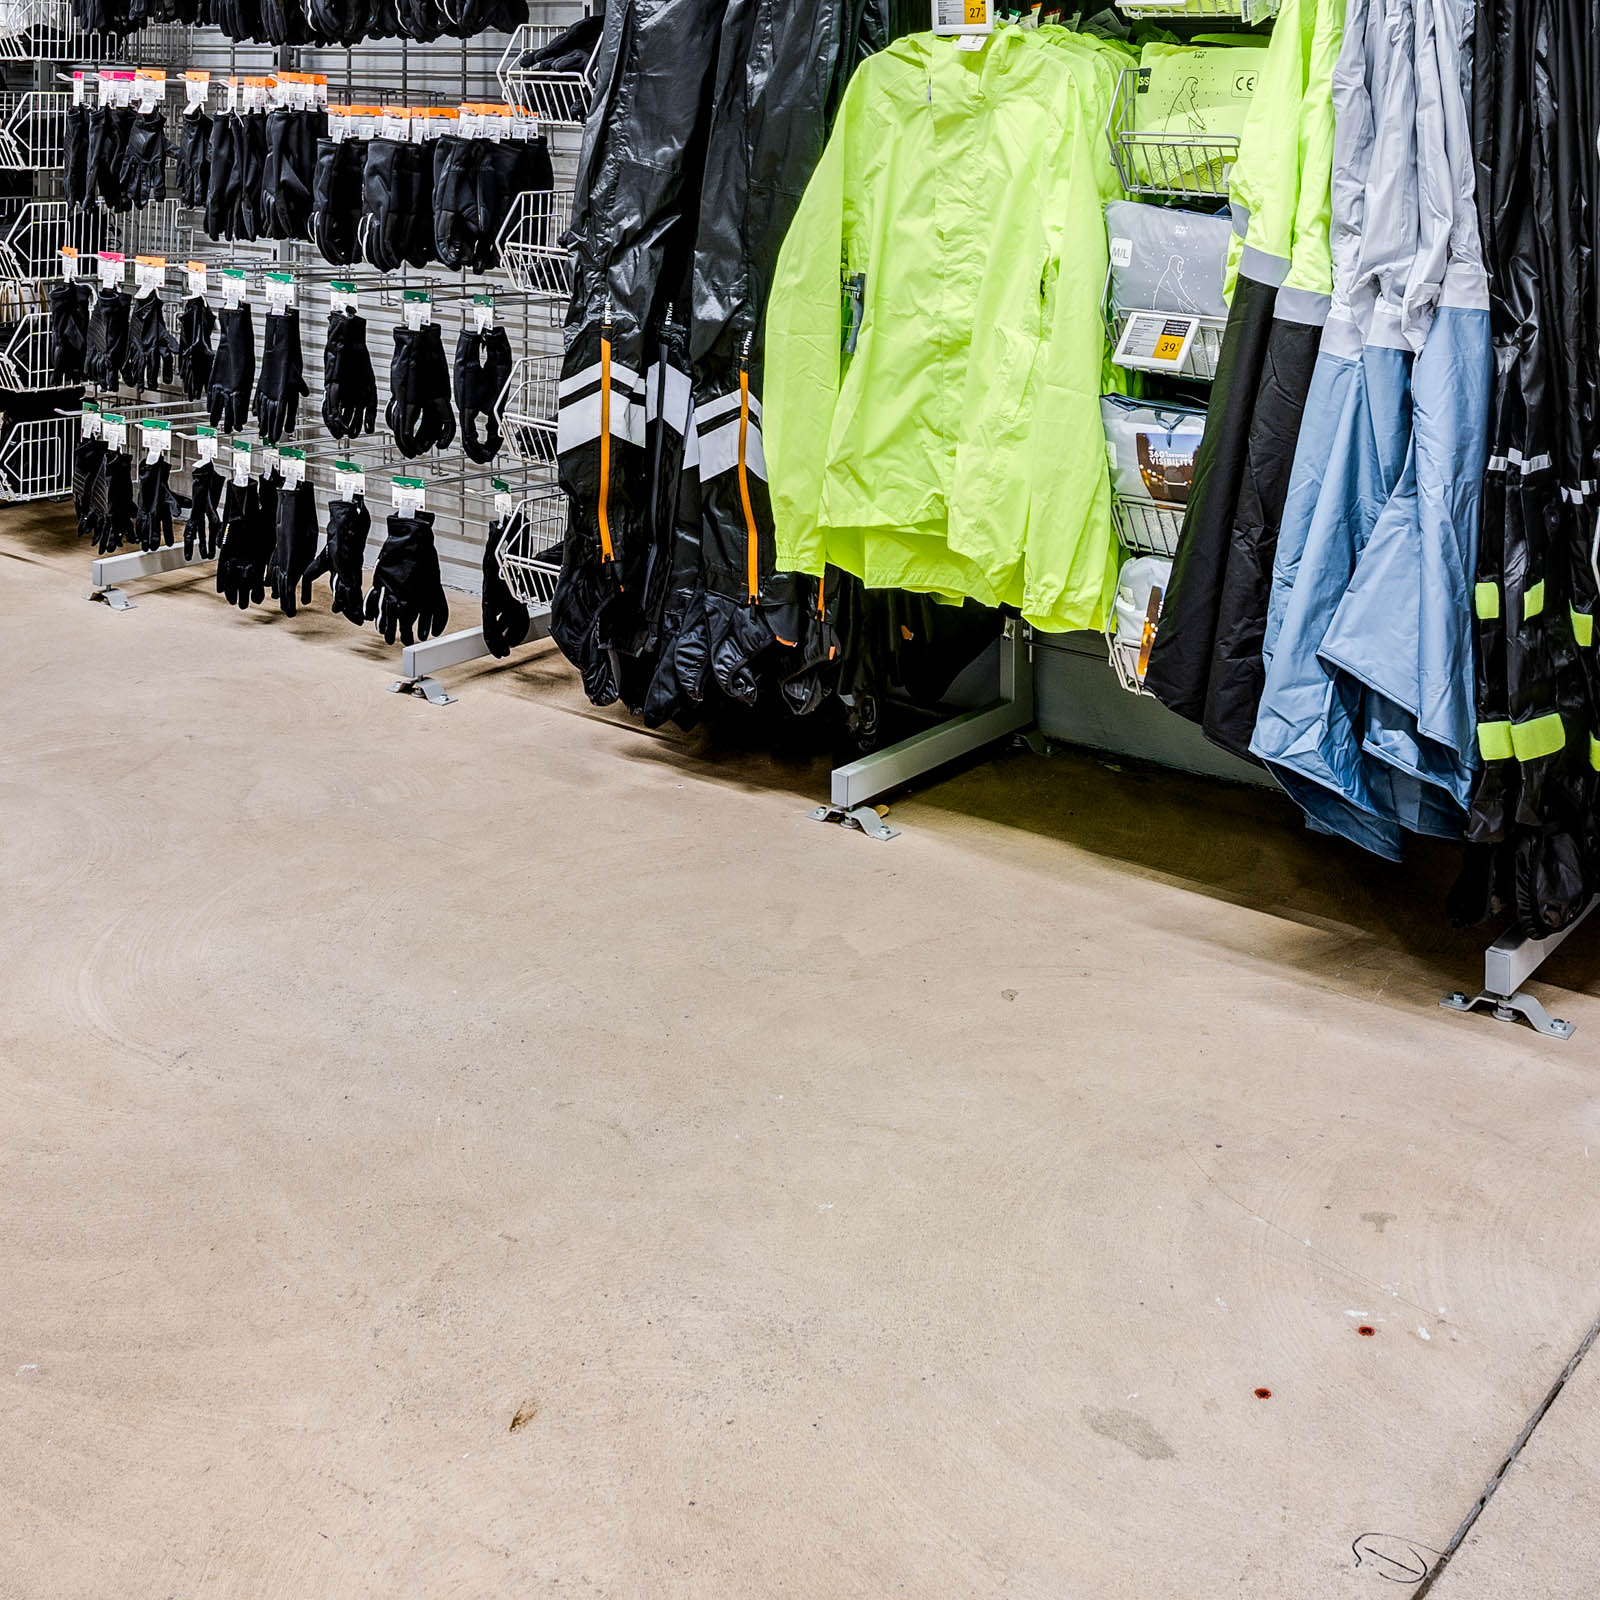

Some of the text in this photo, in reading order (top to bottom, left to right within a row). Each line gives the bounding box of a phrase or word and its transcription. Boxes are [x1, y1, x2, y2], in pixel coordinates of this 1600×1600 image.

[969, 7, 981, 18] 27
[1235, 76, 1254, 91] CE
[1112, 246, 1129, 259] M/L
[742, 330, 753, 355] BTWIN
[1161, 341, 1176, 353] 39
[1149, 457, 1193, 467] VISIBILITY
